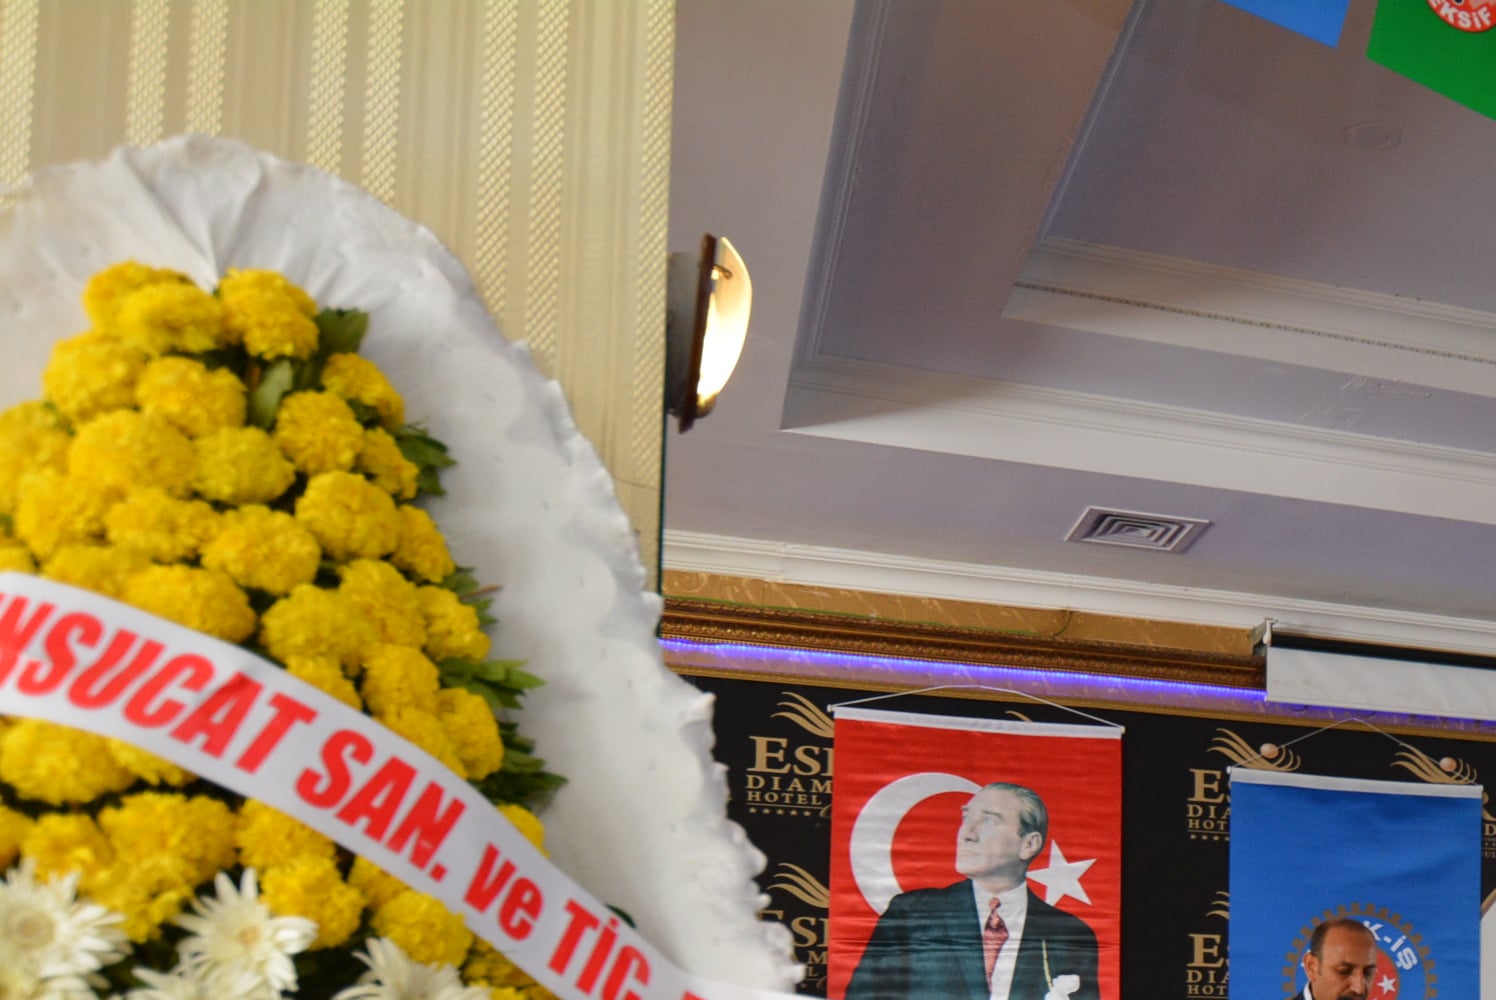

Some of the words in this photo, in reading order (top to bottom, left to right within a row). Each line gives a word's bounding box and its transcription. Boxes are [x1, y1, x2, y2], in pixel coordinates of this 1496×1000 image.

[0, 592, 319, 776] NSUCAT
[294, 729, 448, 883] SAN.
[745, 775, 834, 794] DIAM
[747, 791, 822, 806] HOTEL
[1188, 819, 1228, 830] HOT
[1188, 985, 1228, 996] HOT
